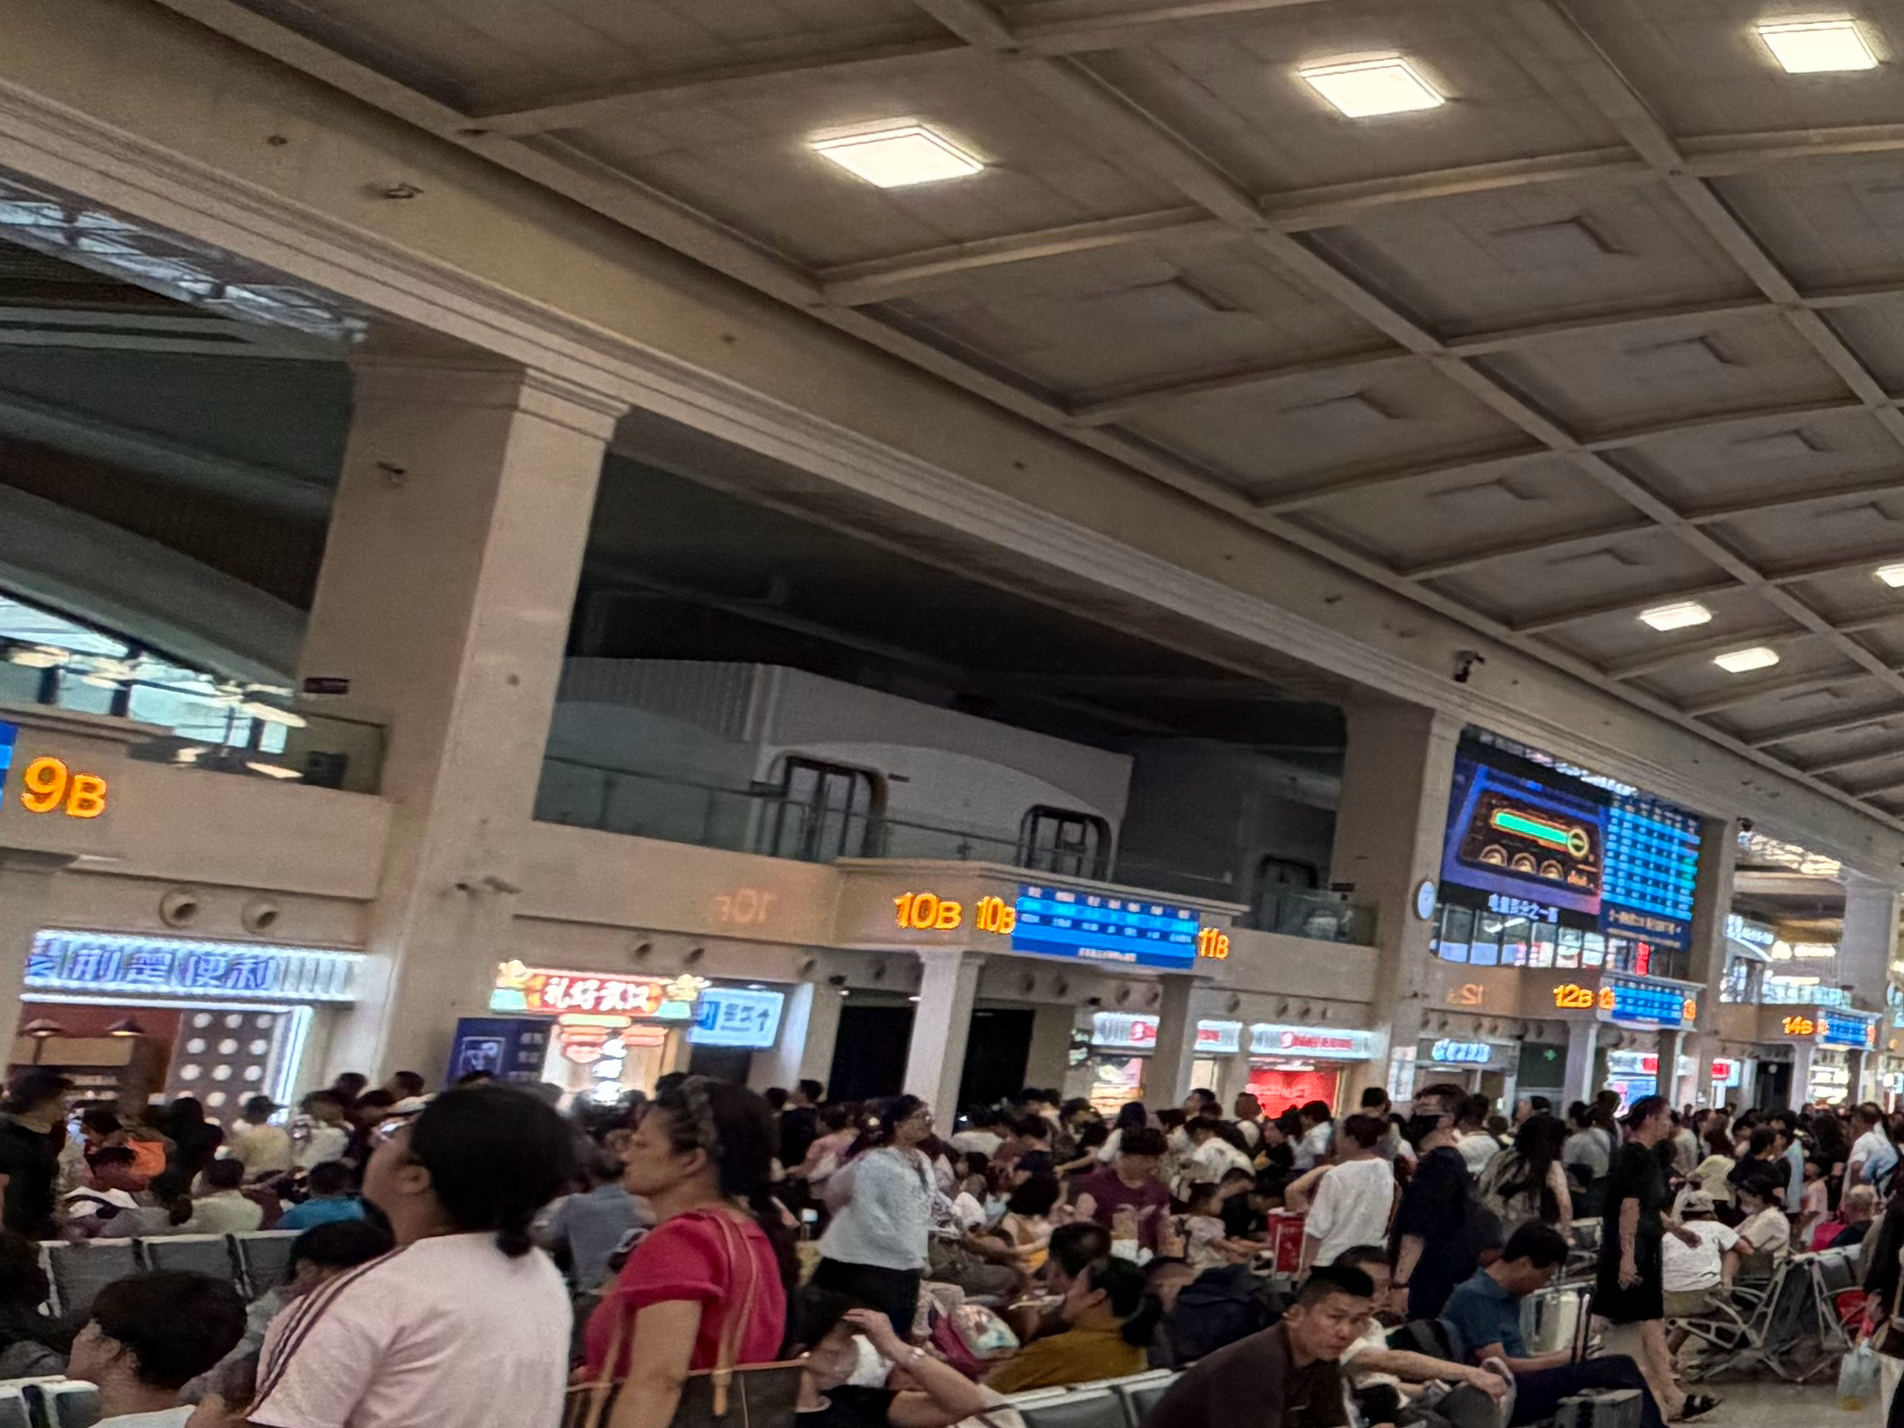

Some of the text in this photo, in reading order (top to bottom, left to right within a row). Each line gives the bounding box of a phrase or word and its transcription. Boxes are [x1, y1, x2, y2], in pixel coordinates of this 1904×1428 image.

[21, 756, 107, 818] 9B
[893, 892, 962, 930] 10B
[976, 895, 1017, 935] 10B
[1199, 927, 1231, 959] 11B
[1553, 983, 1595, 1010] 12B
